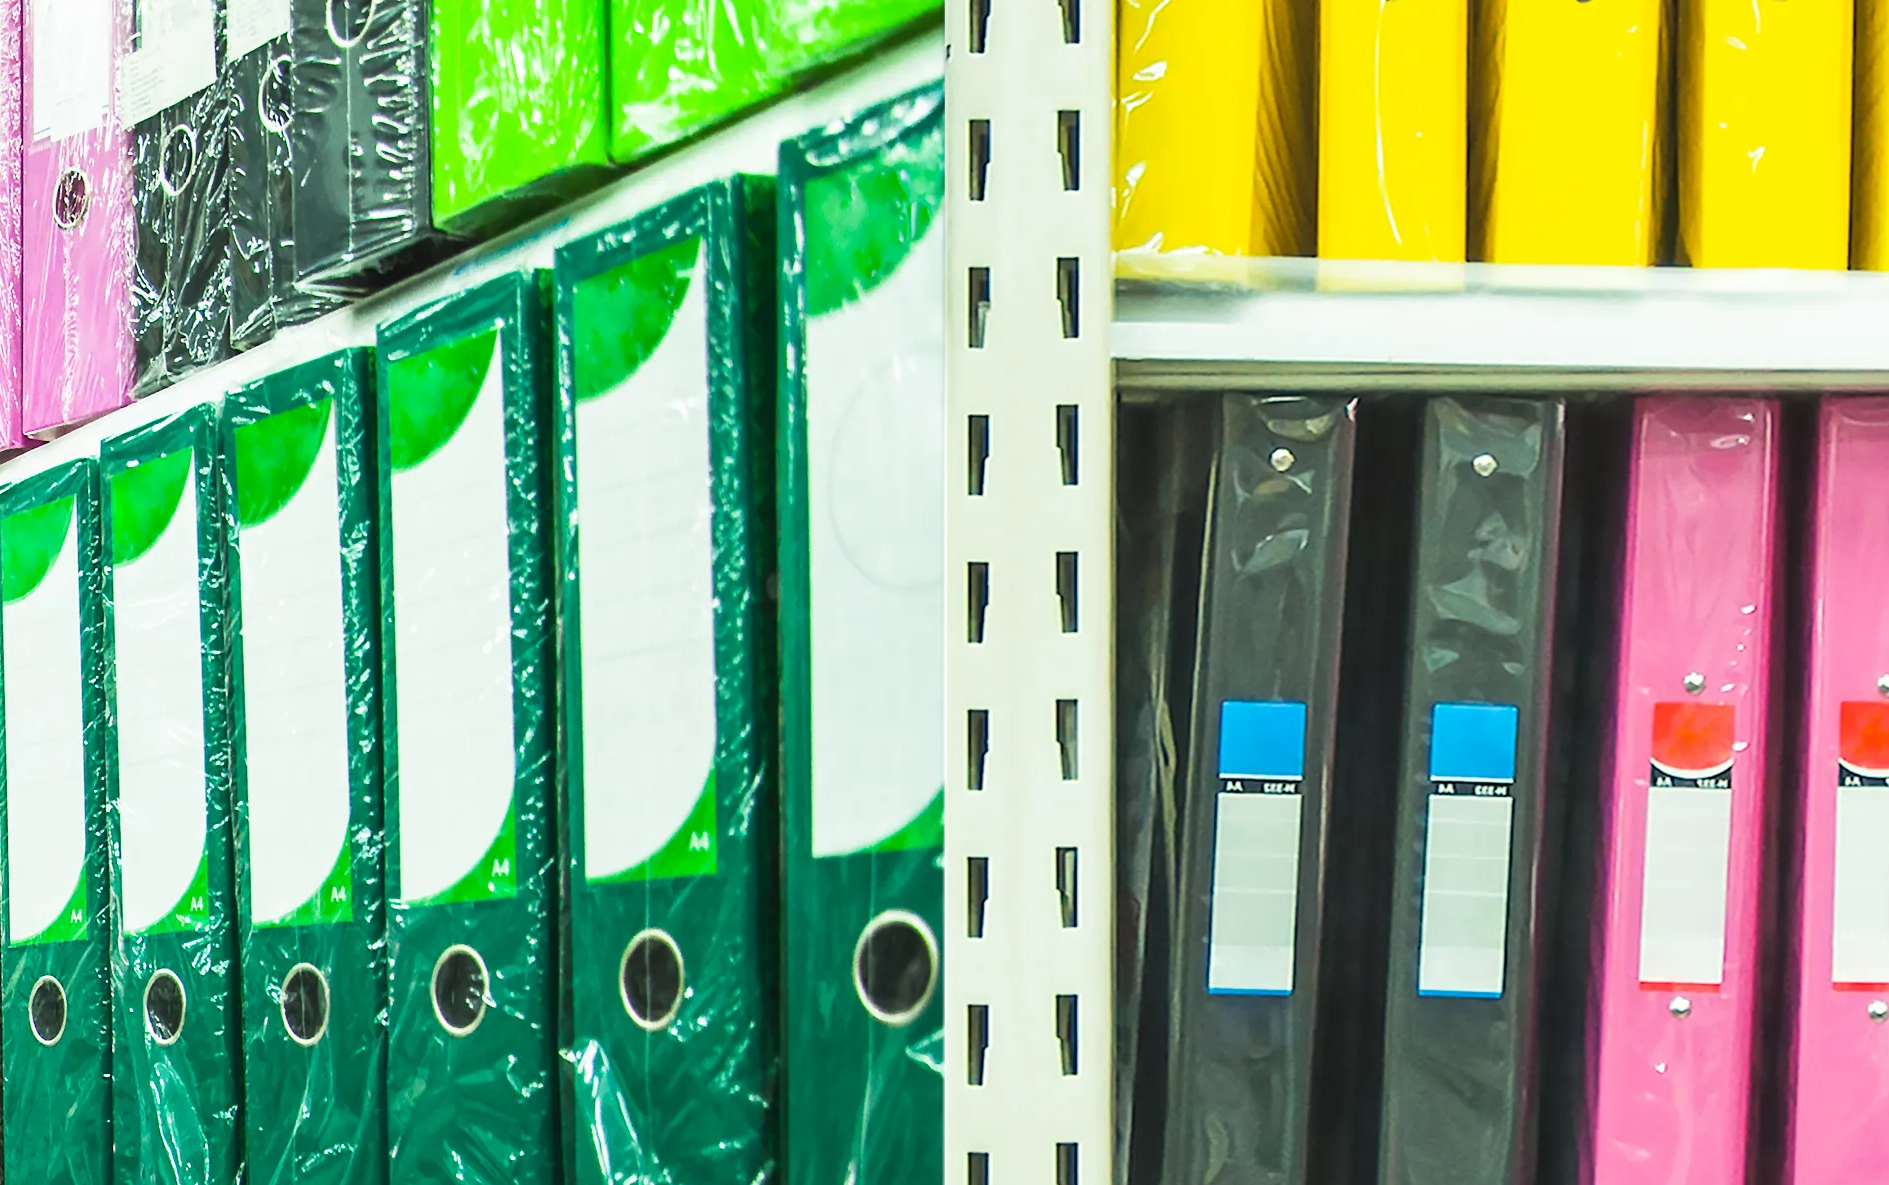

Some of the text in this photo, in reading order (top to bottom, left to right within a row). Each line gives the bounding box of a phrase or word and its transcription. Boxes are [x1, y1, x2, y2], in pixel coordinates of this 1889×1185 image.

[689, 831, 709, 851] A4
[491, 858, 510, 877] A4
[331, 885, 346, 903] A4
[190, 896, 204, 912] A4
[70, 909, 83, 924] A4
